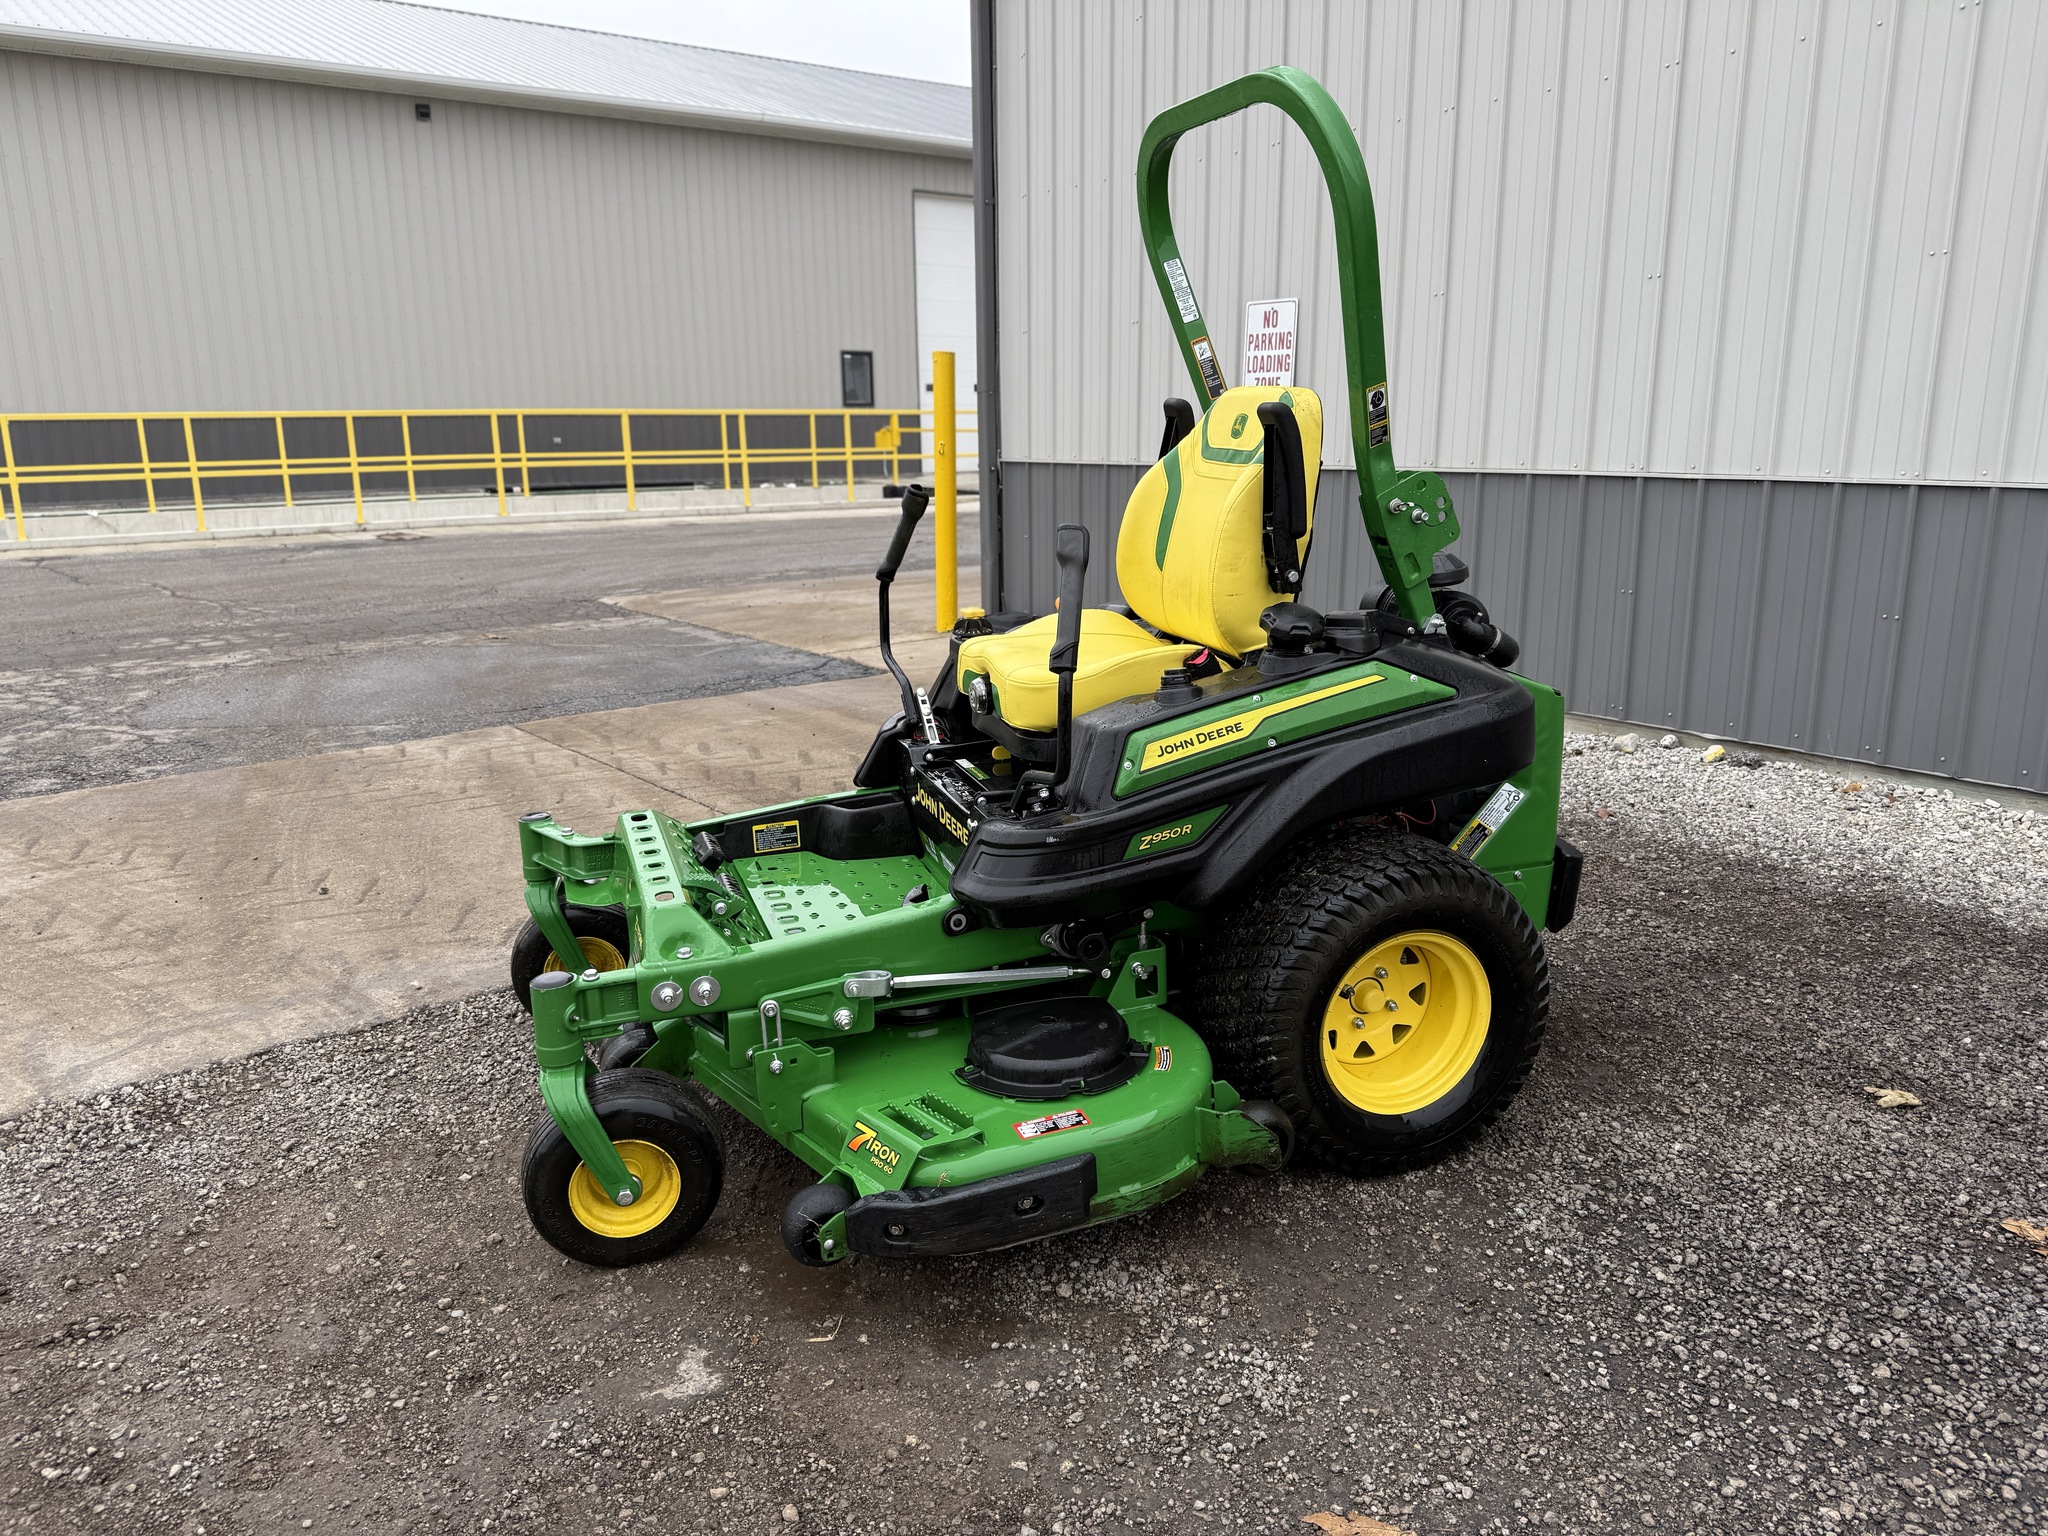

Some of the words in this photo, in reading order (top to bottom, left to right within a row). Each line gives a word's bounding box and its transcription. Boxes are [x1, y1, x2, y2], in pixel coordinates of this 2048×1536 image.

[1263, 309, 1278, 329] NO
[1248, 331, 1292, 352] PARKING
[1247, 353, 1291, 374] LOADING
[1157, 737, 1195, 758] JOHN
[1195, 721, 1244, 745] DEERE
[915, 782, 938, 819] JOHN
[939, 801, 969, 847] DEERE
[1138, 824, 1192, 851] Z950R
[870, 1156, 884, 1169] PRO
[883, 1164, 894, 1175] 60
